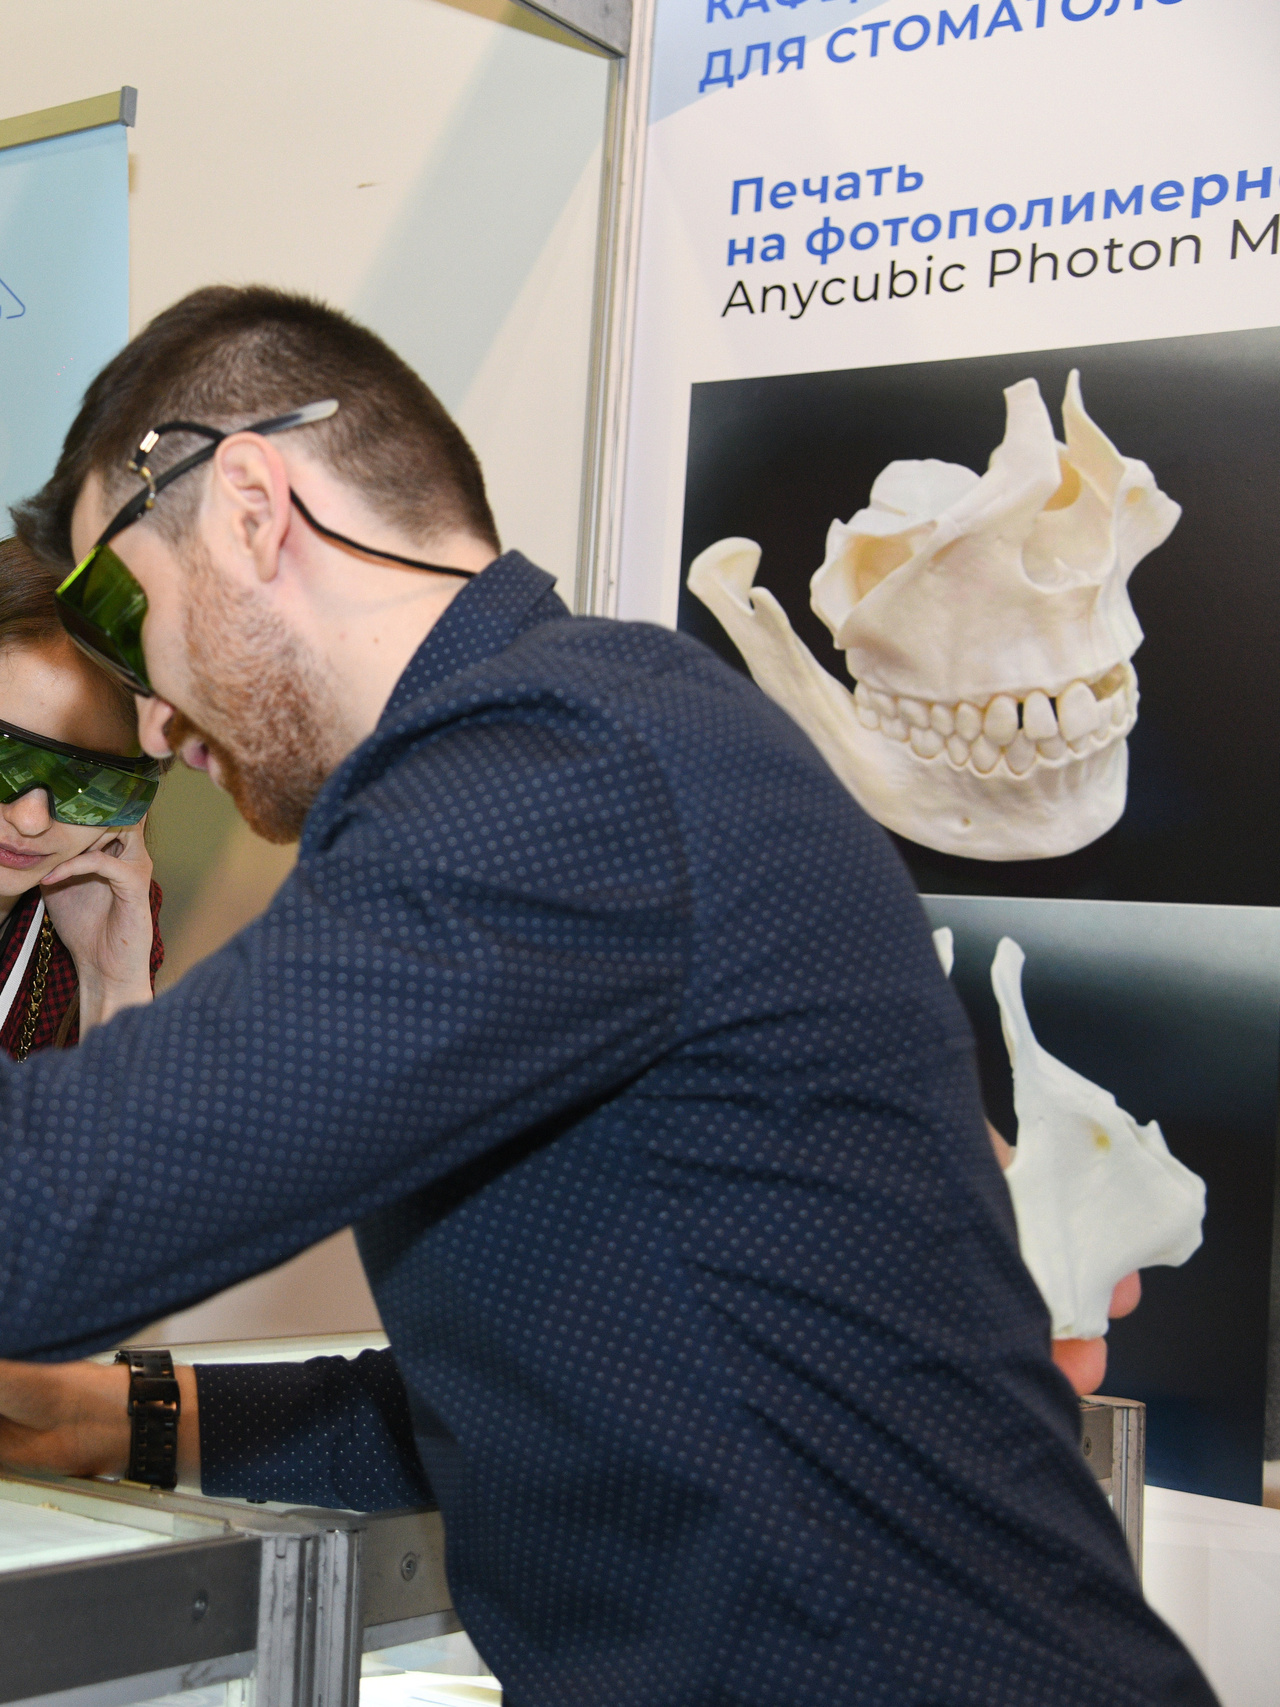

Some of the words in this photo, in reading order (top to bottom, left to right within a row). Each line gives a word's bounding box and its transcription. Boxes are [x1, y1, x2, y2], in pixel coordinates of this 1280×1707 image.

[698, 35, 807, 94] ДЛЯ
[826, 0, 1183, 63] СТОМАТО
[726, 233, 786, 267] на
[806, 166, 1280, 265] фотополимерн
[730, 164, 925, 216] Печать
[721, 259, 967, 320] Anycubic
[989, 234, 1202, 288] Photon
